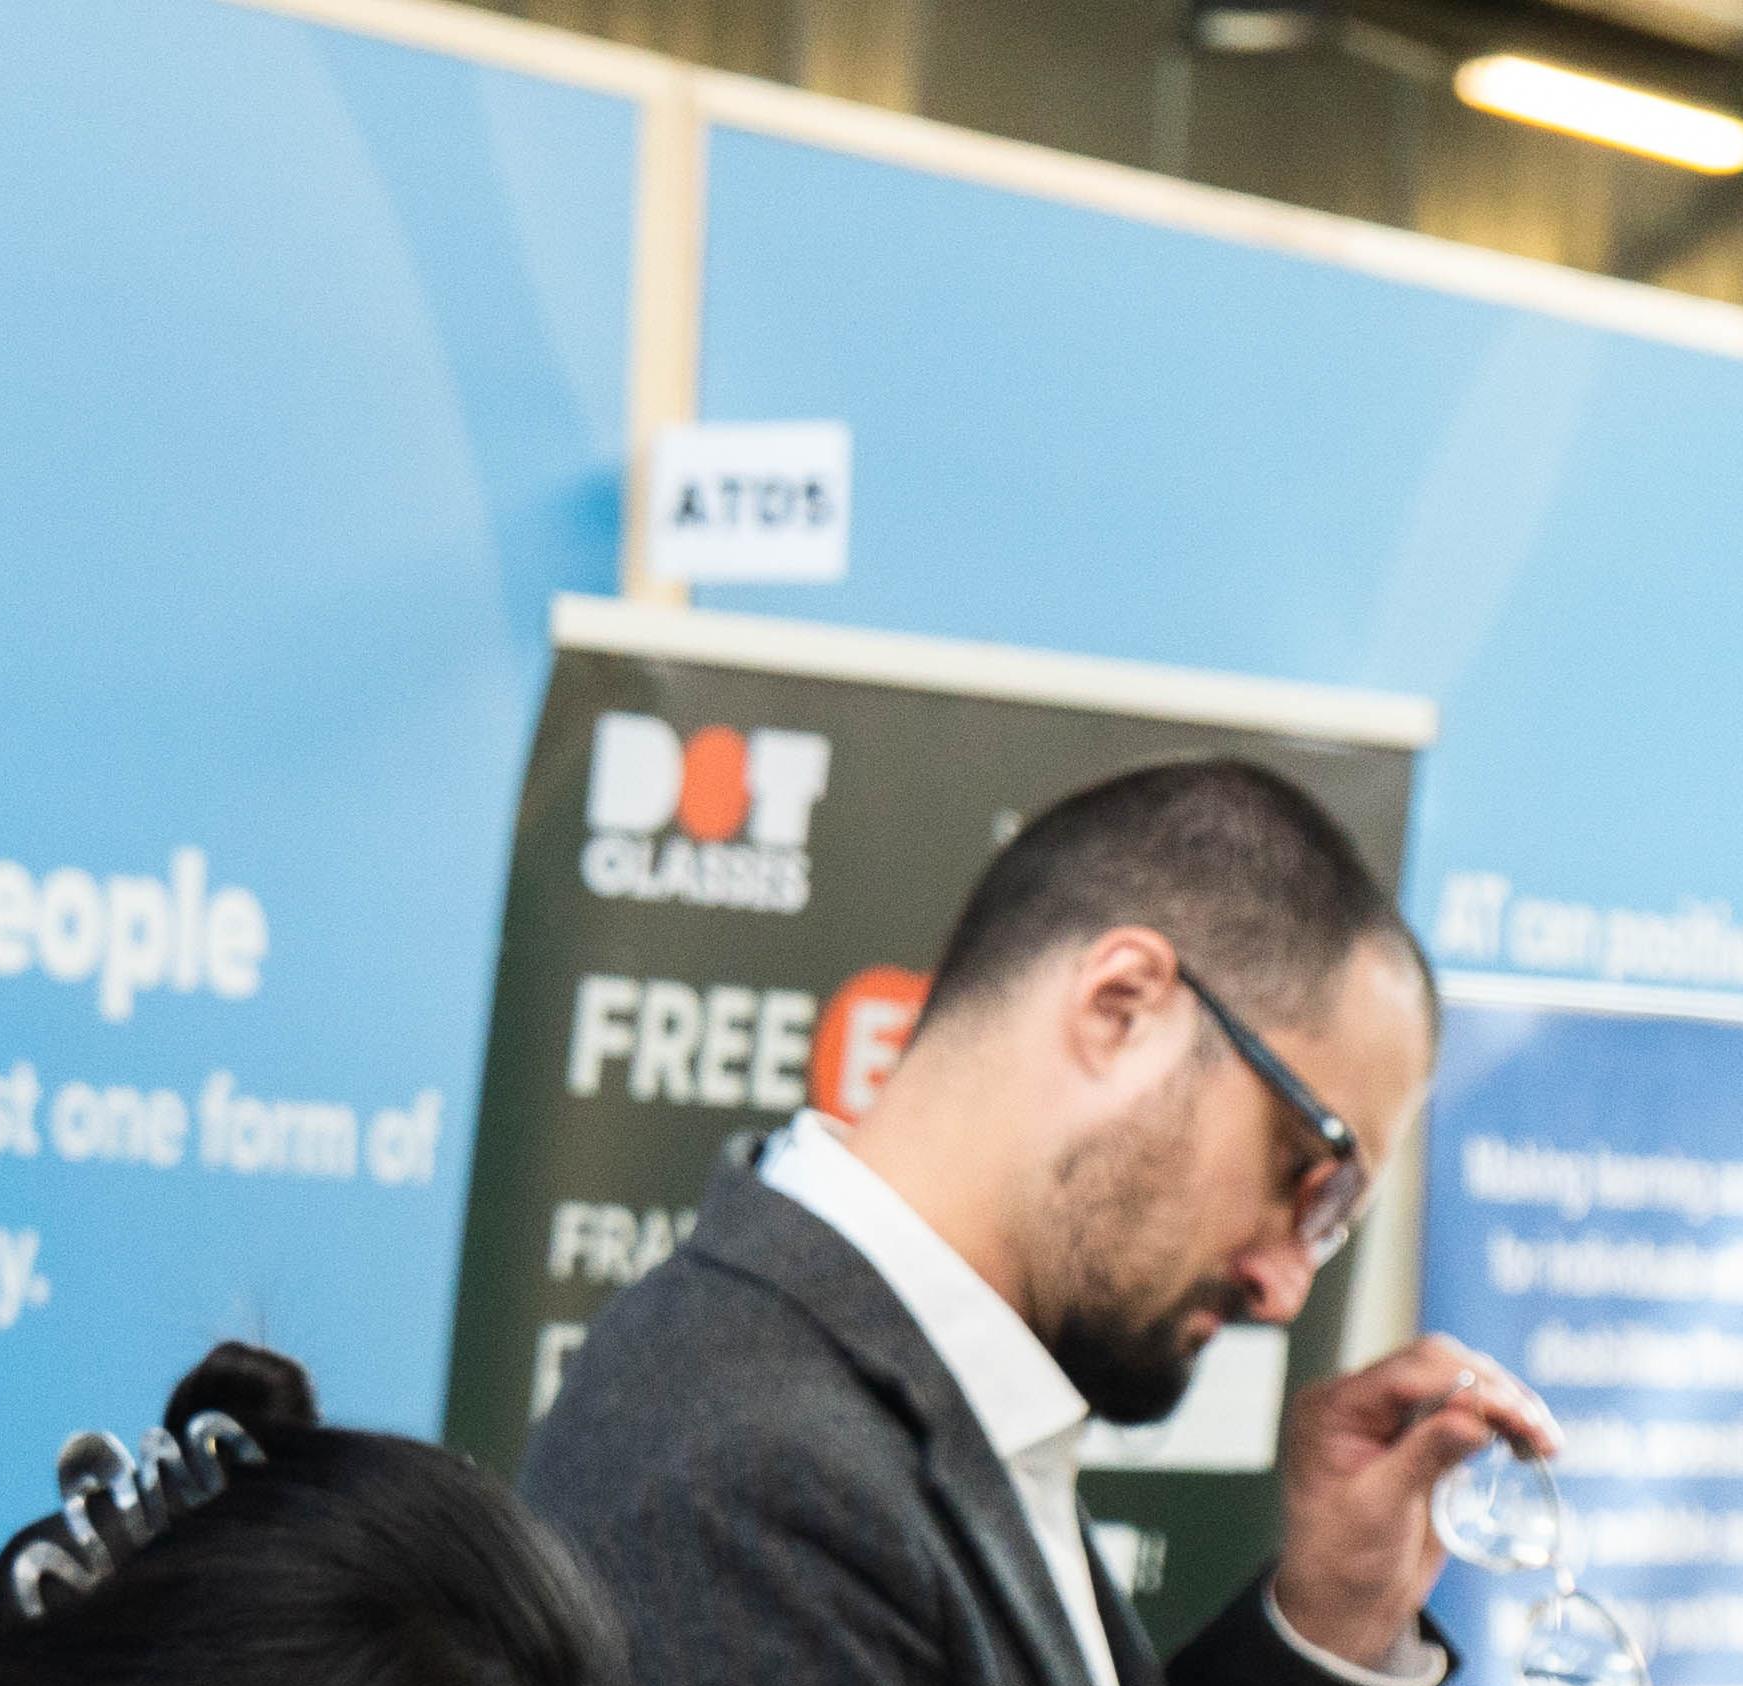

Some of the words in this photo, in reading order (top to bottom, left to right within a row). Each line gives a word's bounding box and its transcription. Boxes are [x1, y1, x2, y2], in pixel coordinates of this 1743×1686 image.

[586, 709, 832, 847] DOT
[580, 834, 811, 915] GLASSES
[566, 973, 818, 1113] FREE
[54, 1080, 187, 1168] one
[201, 1068, 357, 1182] form
[365, 1088, 443, 1186] of
